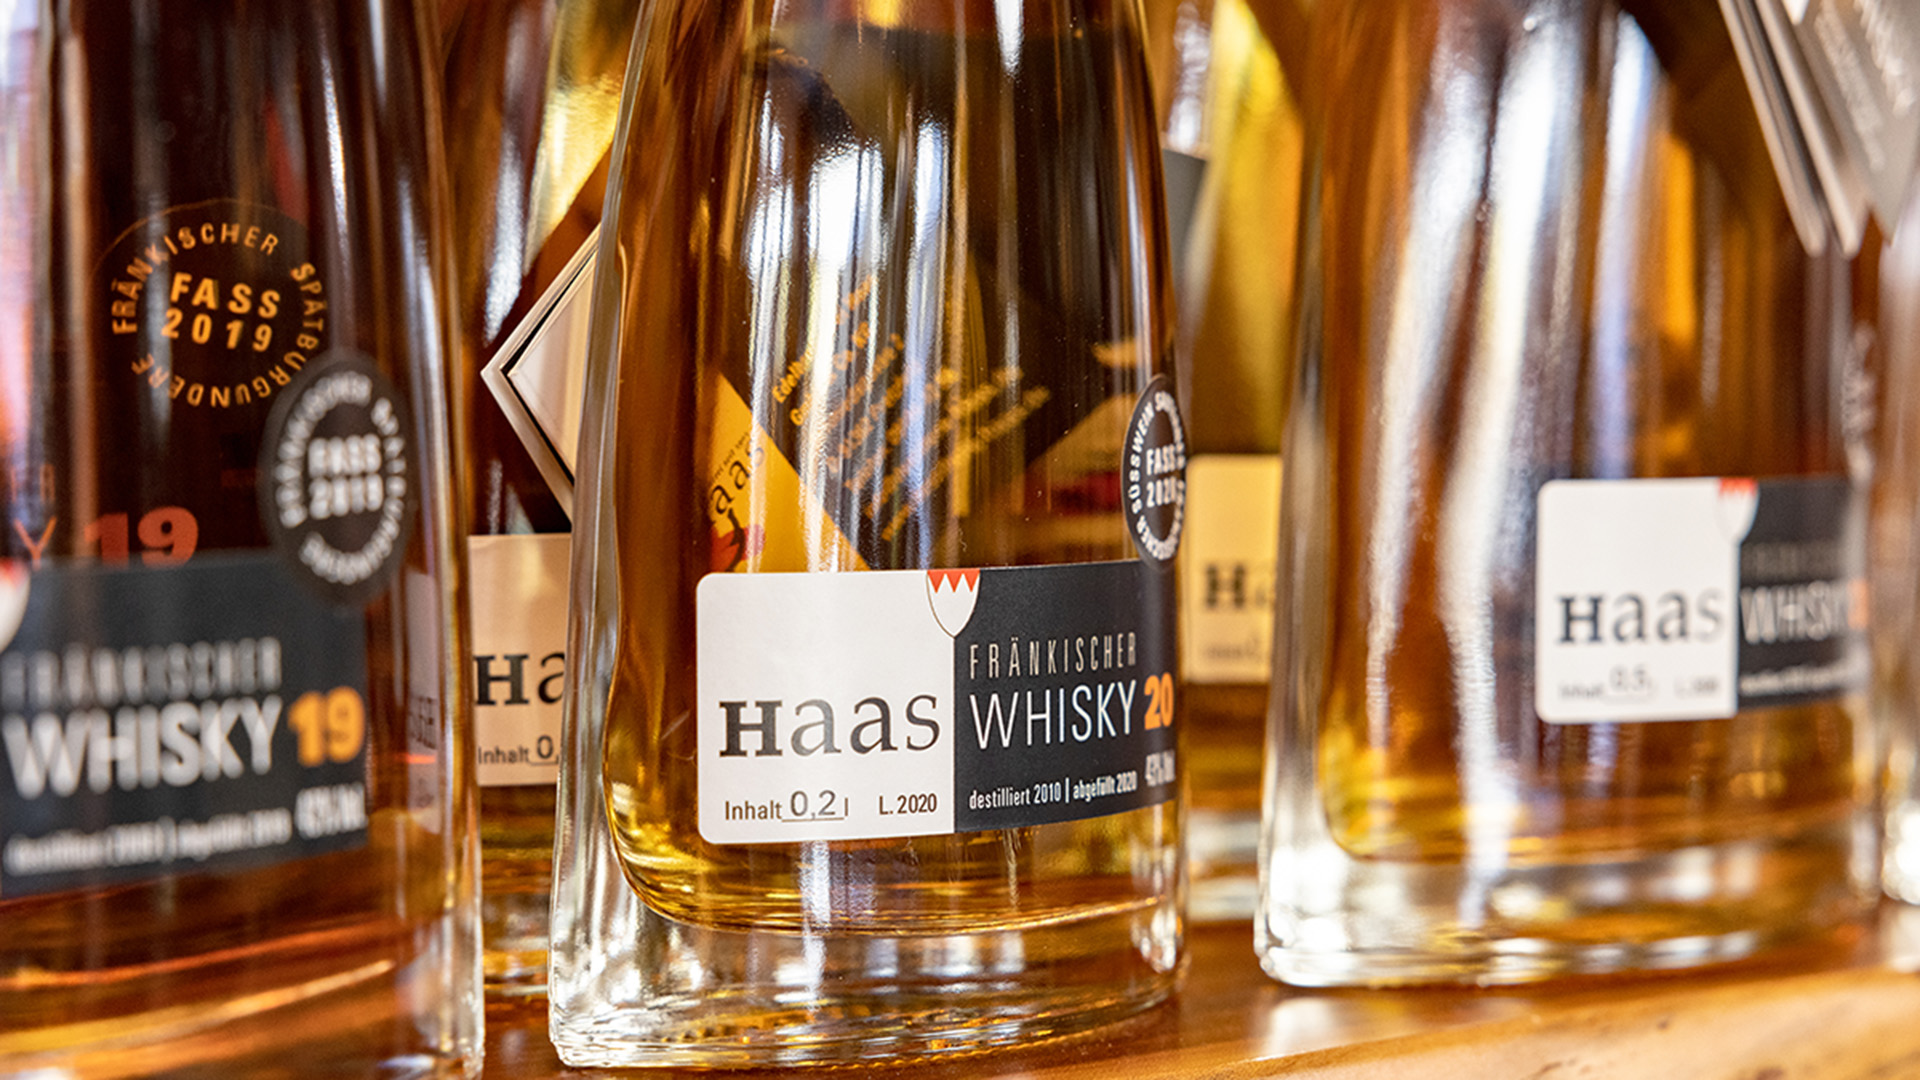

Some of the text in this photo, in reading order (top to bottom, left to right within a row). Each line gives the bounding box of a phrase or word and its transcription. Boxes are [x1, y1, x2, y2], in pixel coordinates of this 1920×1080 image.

[170, 271, 280, 319] FASS
[160, 307, 273, 352] 2019
[83, 506, 199, 570] 19
[1555, 586, 1727, 646] Haas
[969, 631, 1136, 680] FRÄNKISCHER
[719, 694, 941, 758] Haas
[969, 672, 1174, 750] WHISKY 20
[3, 694, 282, 798] WHISKY
[288, 686, 365, 767] 19
[478, 746, 529, 765] Inhalt
[725, 799, 783, 821] Inhalt
[789, 789, 837, 819] 0,2
[969, 788, 1031, 810] destilliert
[1033, 782, 1062, 804] 2010
